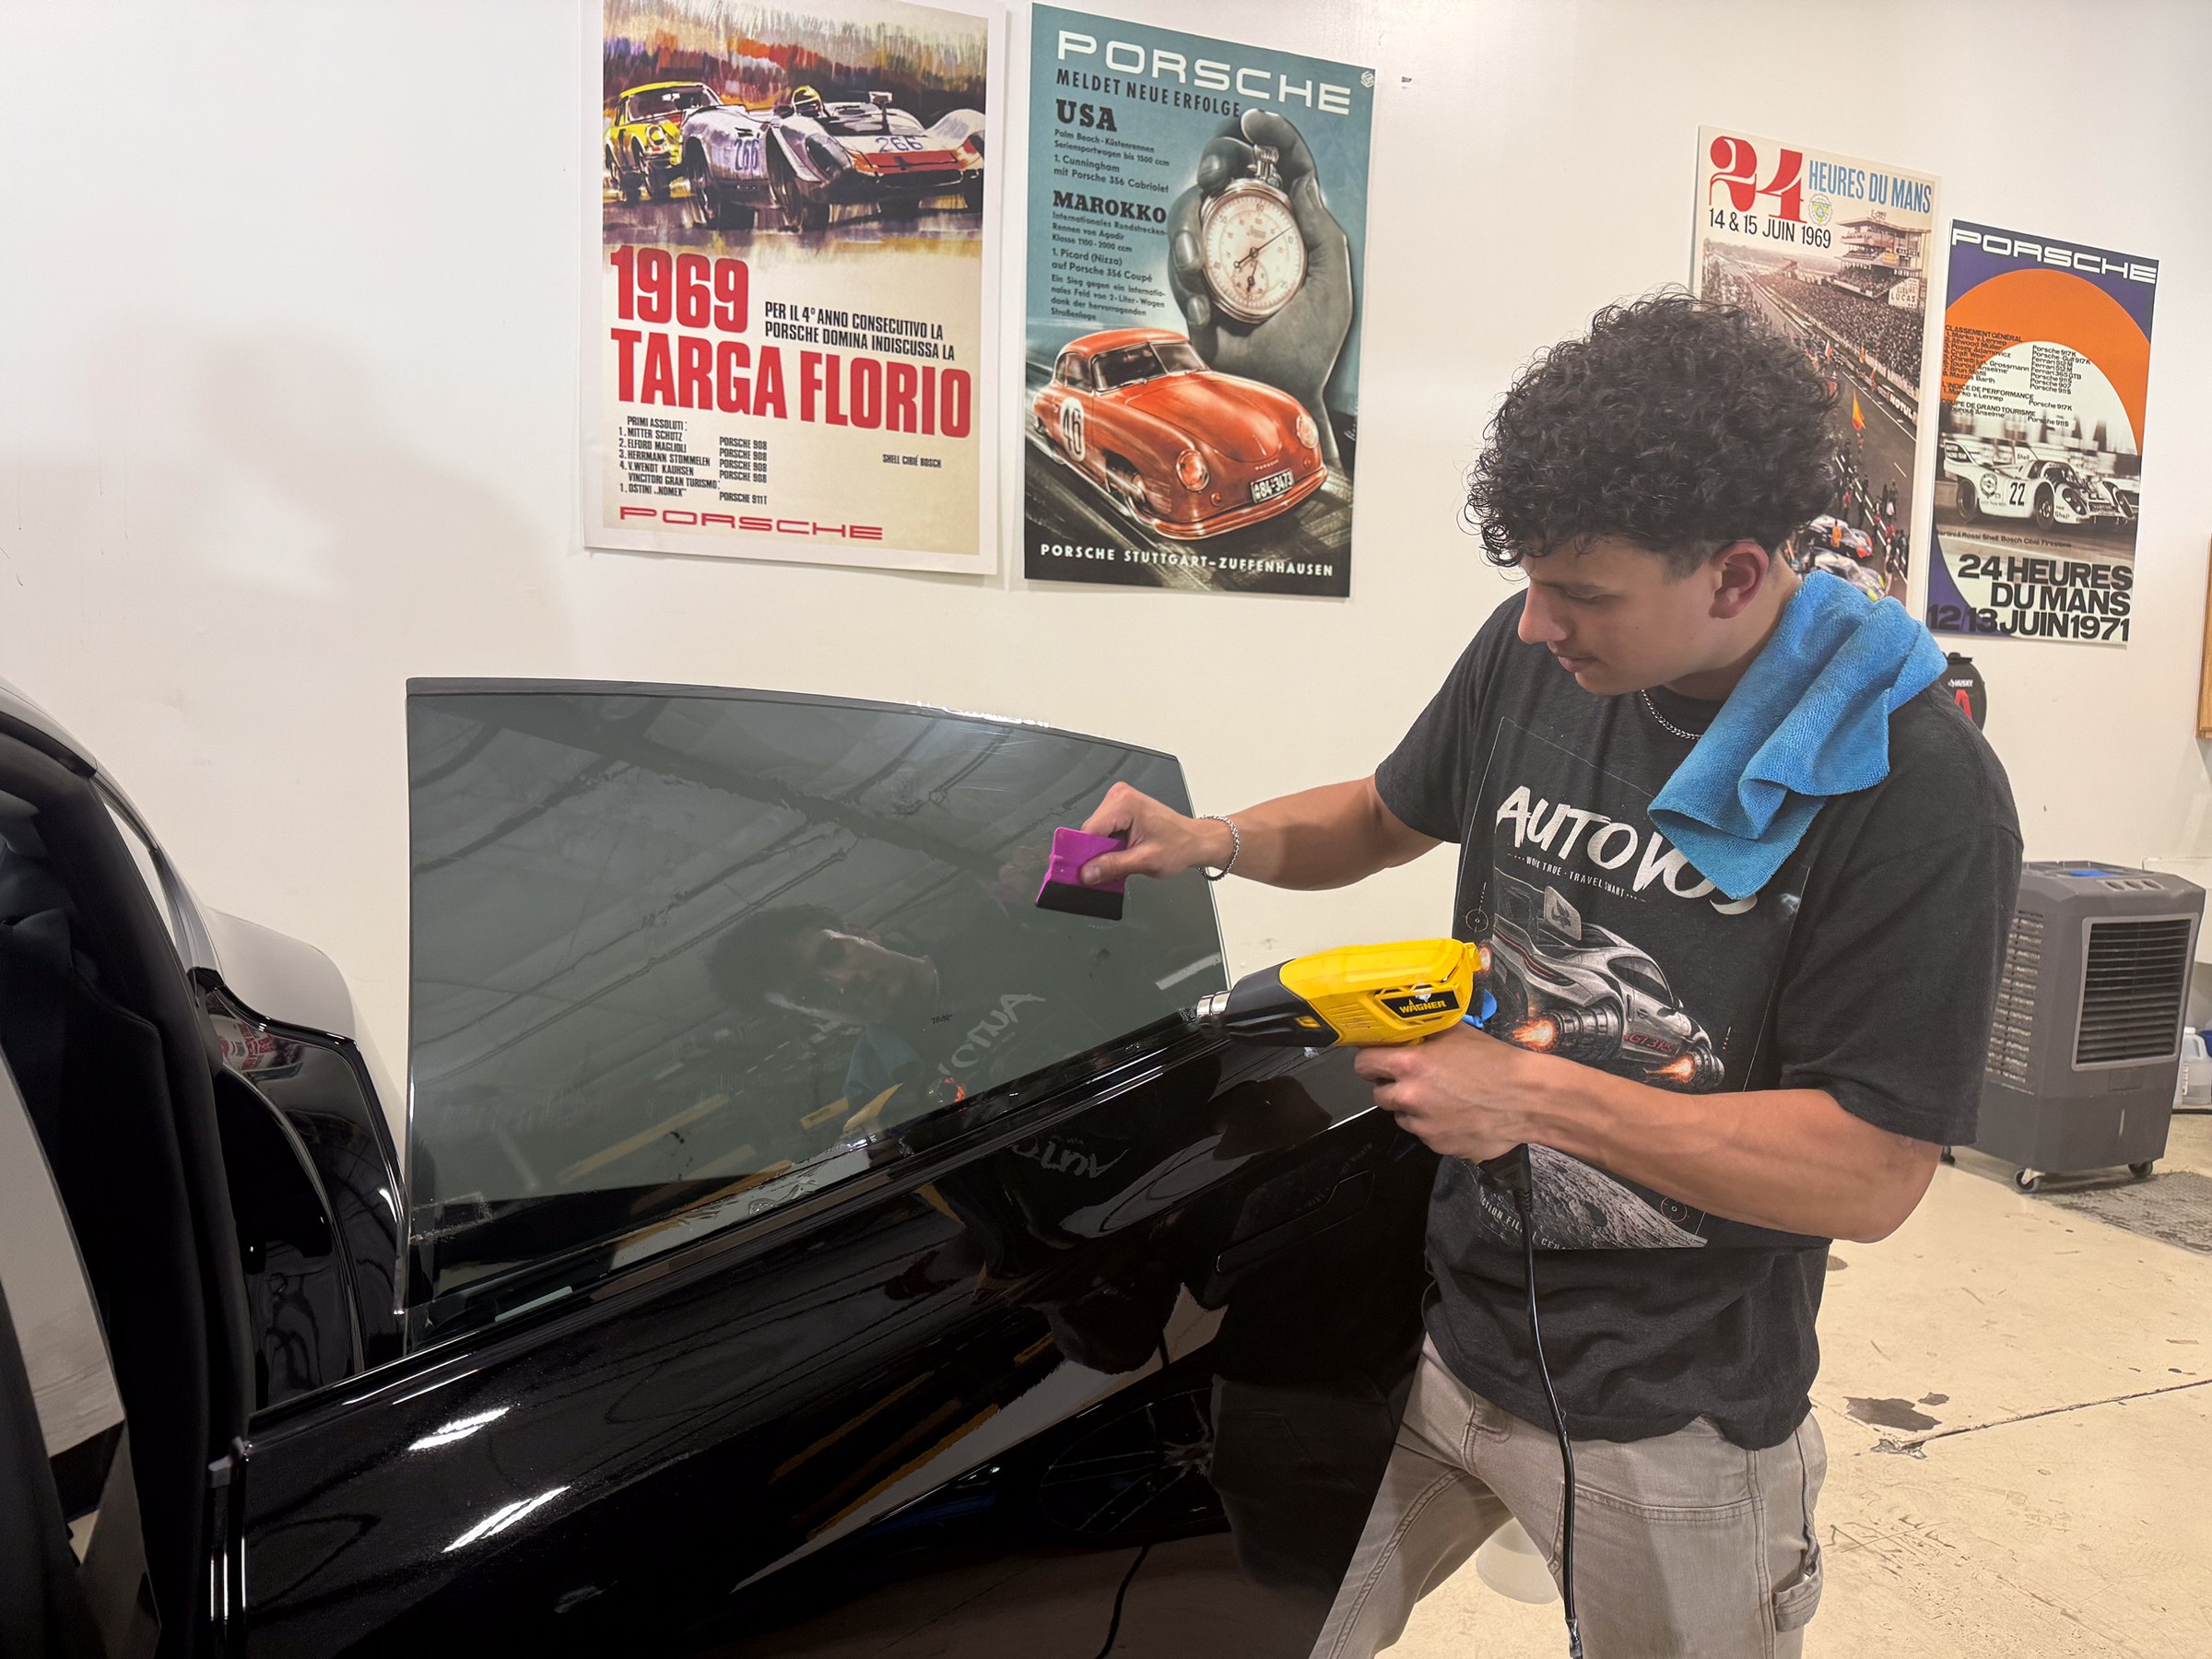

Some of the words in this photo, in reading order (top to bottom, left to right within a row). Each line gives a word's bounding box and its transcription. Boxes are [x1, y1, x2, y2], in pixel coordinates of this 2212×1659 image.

[1058, 29, 1351, 115] PORSCHE
[1056, 69, 1121, 96] MELDET
[1126, 82, 1169, 104] NEUE
[1173, 91, 1240, 118] ERFOLGE
[1056, 99, 1117, 133] USA
[1054, 129, 1074, 138] Palm
[875, 135, 924, 152] 266
[735, 138, 759, 171] 266
[1054, 140, 1122, 159] Seriensportwagen
[1124, 151, 1135, 160] bis
[1154, 159, 1170, 167] ccm
[1053, 154, 1060, 162] 1.
[1062, 155, 1120, 172] Cunningham
[1053, 167, 1068, 176] mit
[1072, 169, 1106, 182] Porsche
[1109, 175, 1124, 186] 356
[1127, 179, 1169, 193] Cabriolet
[1710, 135, 1807, 223] 24
[1808, 159, 1865, 200] HEURES
[1868, 172, 1888, 206] DU
[1890, 177, 1932, 214] MANS
[1053, 190, 1167, 223] MAROKKO
[1053, 211, 1112, 228] Internationales
[1053, 222, 1081, 234] Rennen
[1709, 208, 1725, 229] 14
[1729, 212, 1740, 232] &
[1744, 215, 1758, 235] 15
[1762, 218, 1795, 242] JUIN
[1801, 226, 1831, 249] 1969
[1052, 248, 1058, 257] 1.
[1061, 249, 1088, 261] Picard
[1951, 228, 2158, 285] PORSCHE
[1052, 262, 1067, 270] auf
[1069, 262, 1104, 276] Porsche
[1107, 268, 1122, 277] 356
[611, 245, 748, 334] 1969
[1052, 274, 1063, 283] Ein
[1066, 276, 1083, 287] Sieg
[1086, 280, 1110, 289] gegen
[1074, 288, 1090, 298] Feld
[1890, 292, 1916, 302] LUCAS
[765, 301, 786, 320] PER
[790, 305, 800, 322] IL
[802, 307, 817, 323] 4°
[817, 309, 848, 328] ANNO
[852, 313, 927, 338] CONSECUTIVO
[931, 324, 943, 340] LA
[765, 321, 819, 344] PORSCHE
[823, 327, 868, 349] DOMINA
[871, 333, 938, 359] INDISCUSSA
[942, 344, 955, 360] LA
[611, 327, 787, 420] TARGA
[800, 350, 971, 439] FLORIO
[1982, 387, 2034, 400] PERFORMANCE
[1976, 403, 2001, 412] GRAND
[2002, 406, 2036, 418] TOURISME
[2029, 399, 2056, 409] Porsche
[627, 416, 648, 428] PRIMI
[1062, 405, 1083, 454] 46
[618, 427, 627, 437] 1.
[628, 428, 653, 439] MITTER
[618, 438, 627, 448] 2.
[628, 439, 653, 451] ELFORD
[655, 441, 687, 453] MAGLIOLI
[719, 437, 751, 450] PORSCHE
[753, 440, 767, 451] 908
[618, 449, 627, 459] 3.
[628, 450, 667, 463] HERRMANN
[669, 453, 711, 466] STOMMELEN
[719, 448, 751, 461] PORSCHE
[753, 451, 767, 462] 908
[619, 461, 627, 470] 4.
[662, 465, 694, 477] KAUHSEN
[719, 459, 751, 472] PORSCHE
[753, 462, 767, 472] 908
[629, 473, 663, 485] VINCITORI
[665, 476, 685, 487] GRAN
[719, 470, 751, 482] PORSCHE
[753, 473, 767, 483] 908
[620, 483, 628, 493] 1.
[629, 484, 653, 495] OSTINI
[719, 491, 751, 503] PORSCHE
[2009, 482, 2026, 506] 22
[619, 506, 883, 541] PORSCHE
[1041, 544, 1115, 560] PORSCHE
[1124, 550, 1334, 576] STUTTGART-ZUFFENHAUSEN
[1958, 554, 2003, 581] 24
[2006, 556, 2134, 591] HEURES
[1990, 582, 2035, 609] DU
[2040, 585, 2132, 617] MANS
[1927, 604, 1998, 633] 12/13
[2000, 609, 2069, 639] JUIN
[2070, 614, 2131, 641] 1971
[1955, 679, 1973, 688] HUSKY
[1542, 862, 1562, 877] TRUE
[1570, 871, 1603, 888] TRAVEL
[1398, 998, 1447, 1014] WAGNER
